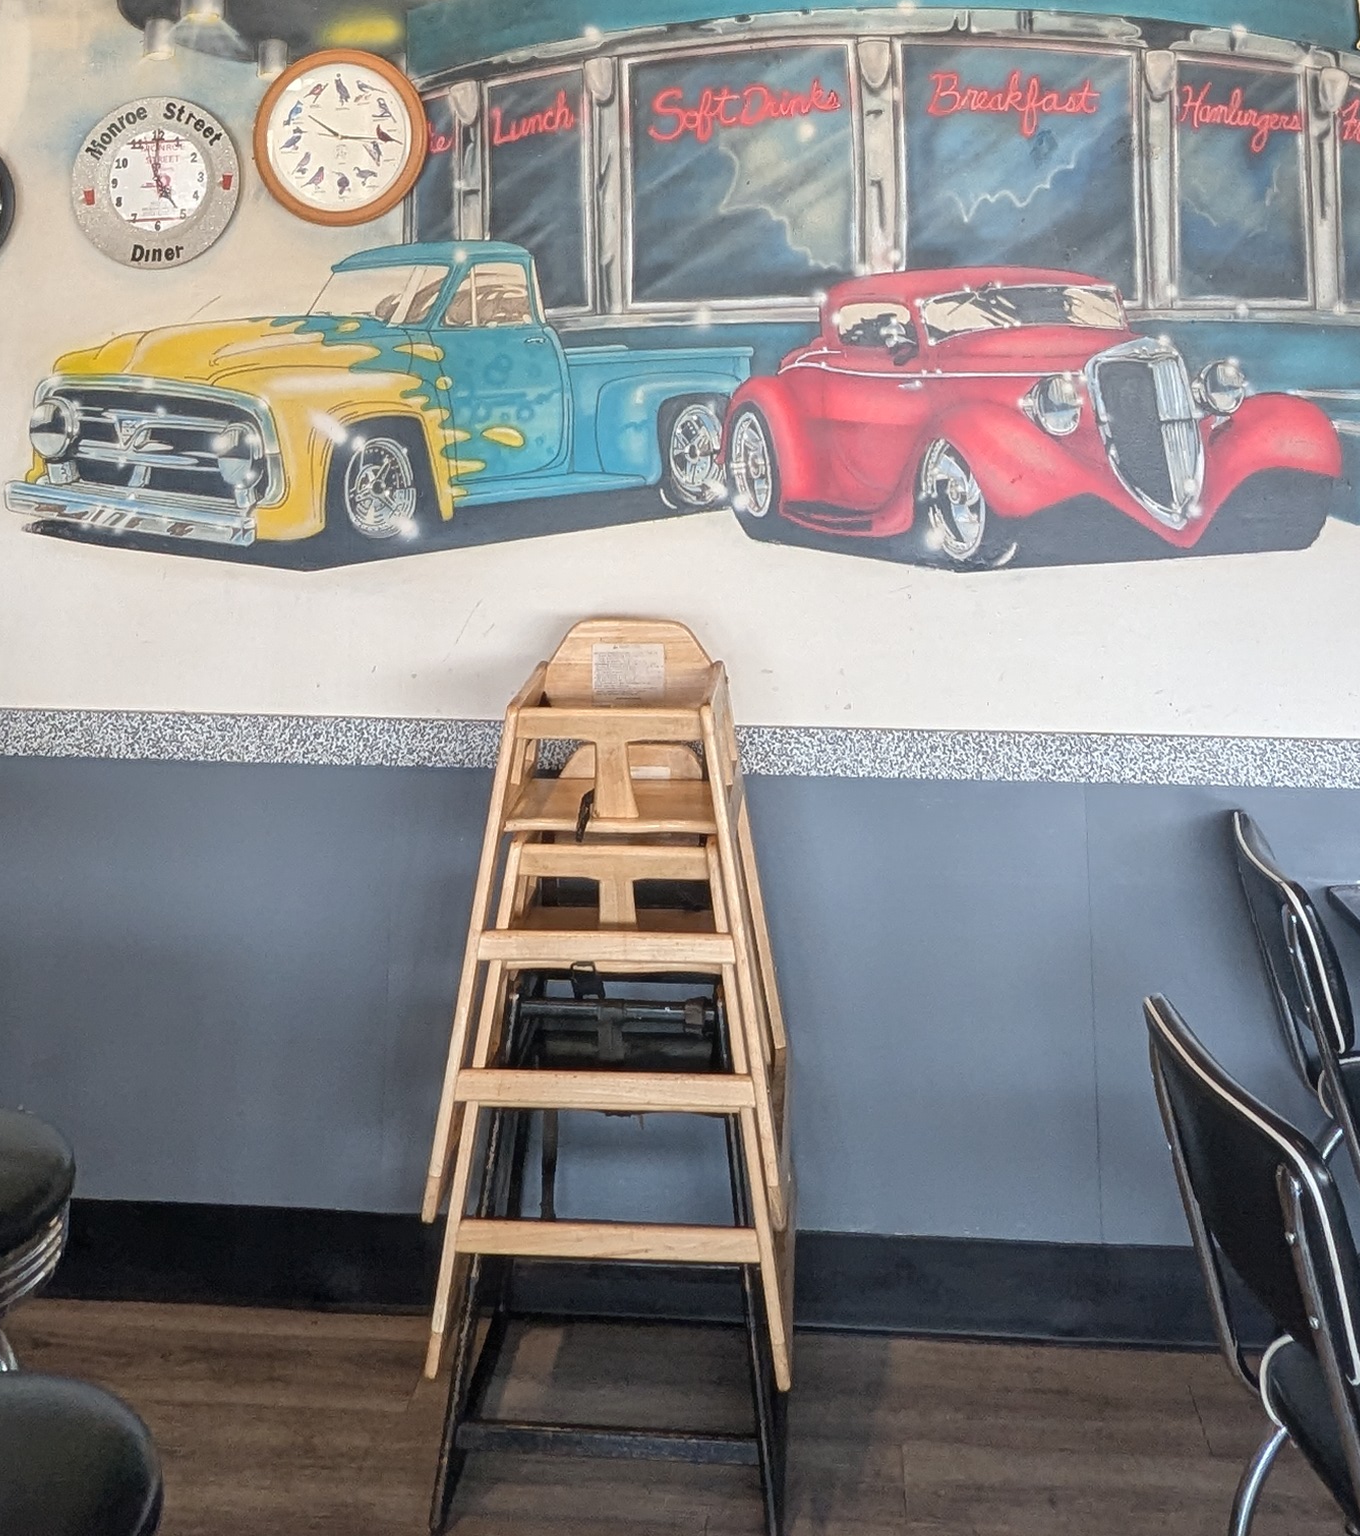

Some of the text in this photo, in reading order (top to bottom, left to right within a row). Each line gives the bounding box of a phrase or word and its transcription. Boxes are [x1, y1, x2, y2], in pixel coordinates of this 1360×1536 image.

[927, 70, 1099, 137] Breakfast
[647, 77, 840, 143] Soft Drinks
[426, 89, 575, 154] ie Lunch
[1180, 83, 1303, 153] Hamburgers
[85, 102, 222, 161] Monroe Street
[115, 158, 128, 168] 10
[190, 153, 197, 163] 2
[111, 178, 118, 188] 9
[197, 172, 204, 183] 3
[193, 191, 199, 201] 4
[116, 197, 122, 207] 8
[155, 221, 161, 231] 6
[131, 244, 184, 262] Diner
